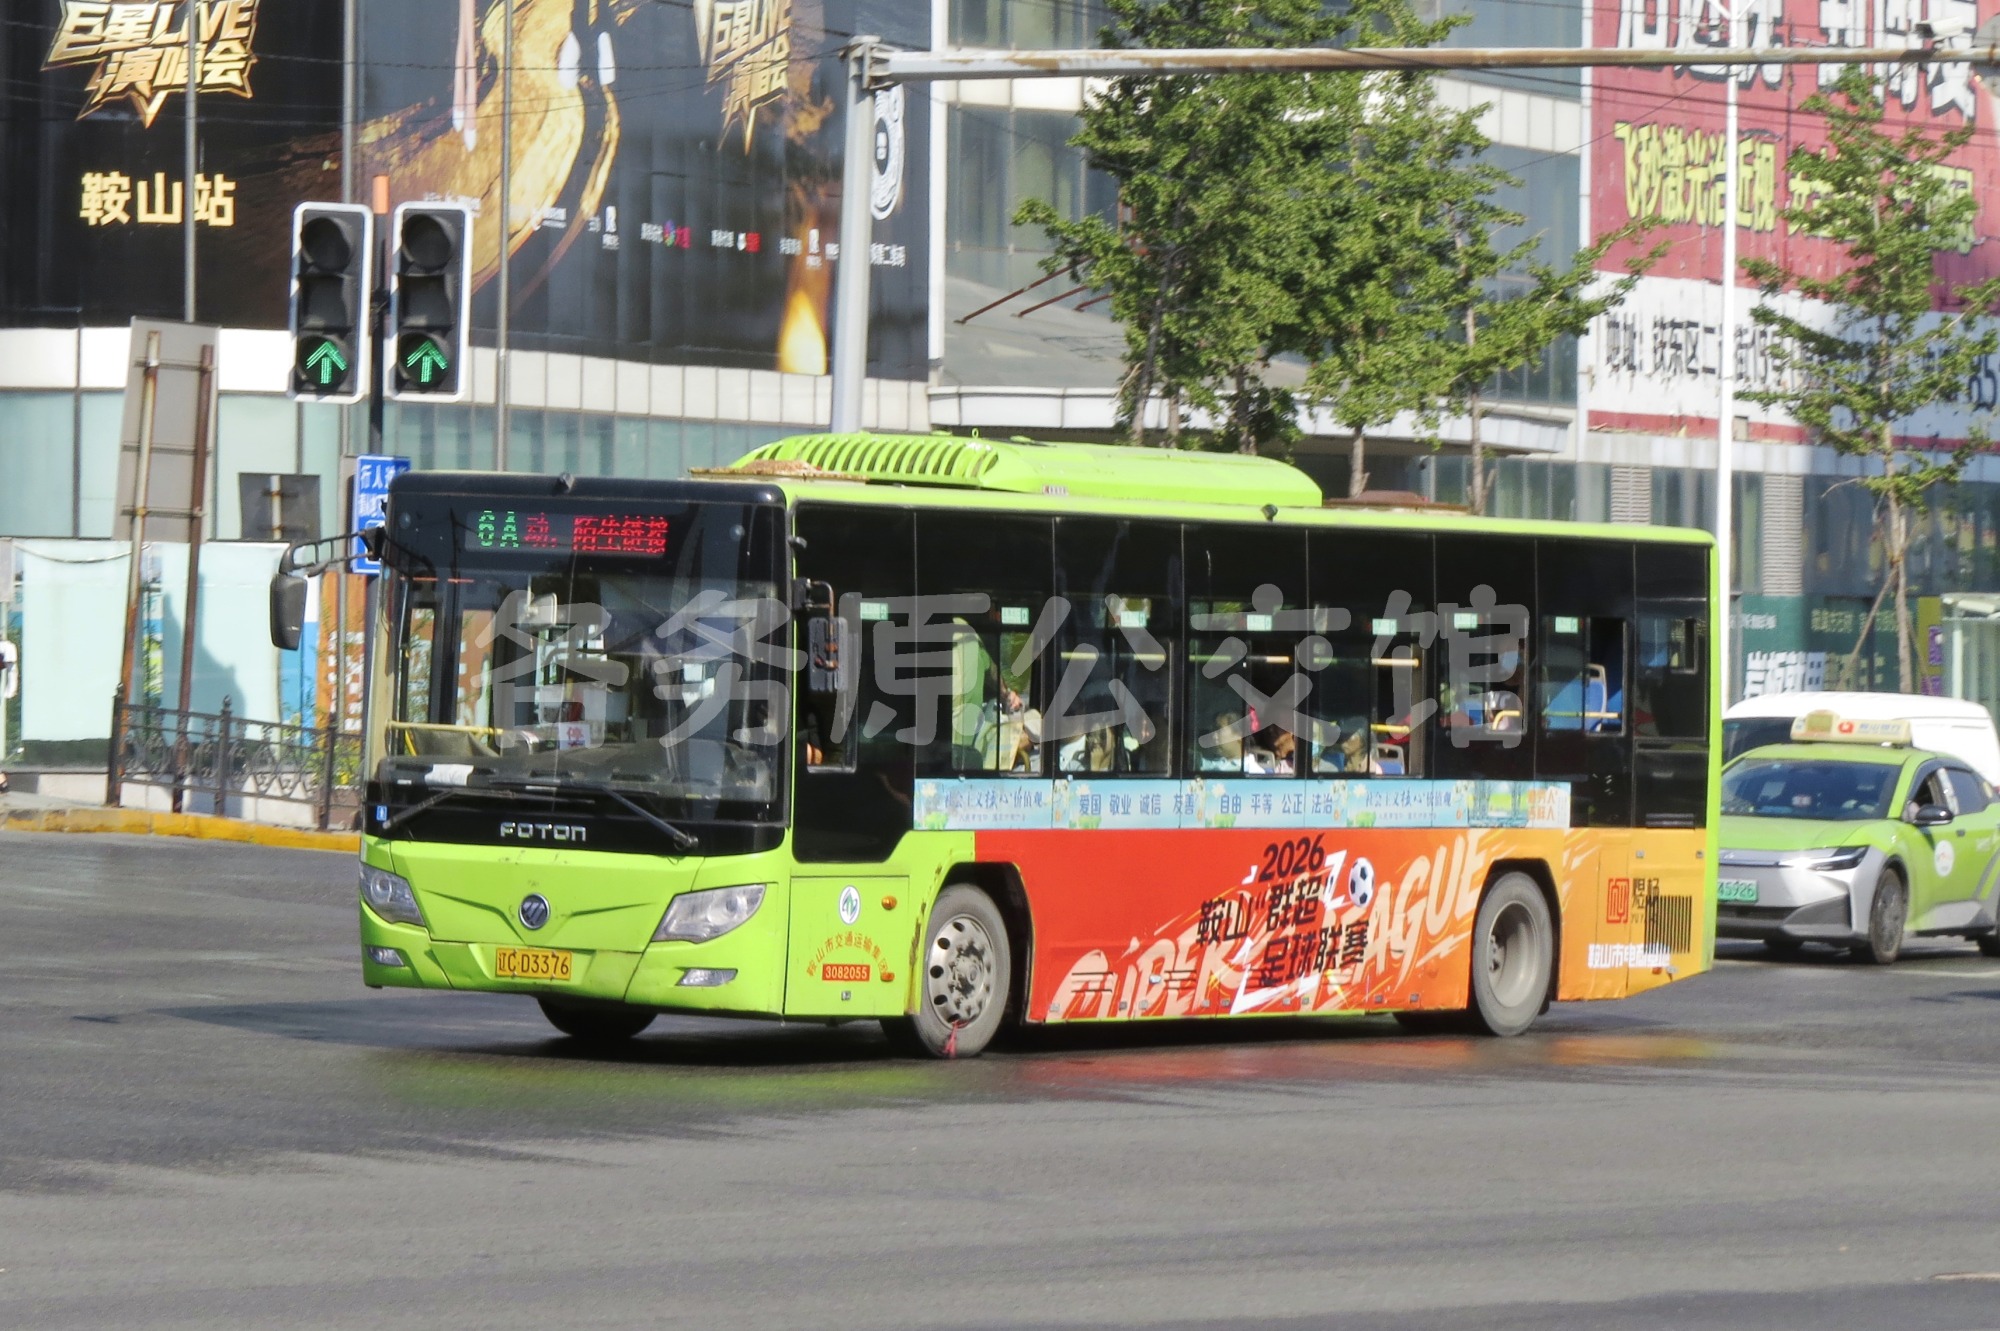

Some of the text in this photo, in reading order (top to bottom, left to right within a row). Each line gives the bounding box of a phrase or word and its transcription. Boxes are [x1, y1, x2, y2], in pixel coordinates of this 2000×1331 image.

[91, 39, 248, 104] 演唱会
[80, 172, 236, 227] 鞍山站
[478, 510, 519, 547] 6A
[1079, 794, 1195, 816] 爱国 敬业 诚信 友善
[1220, 794, 1333, 815] 自由 平等 公正 法治
[500, 822, 586, 842] FOTON
[1258, 833, 1325, 882] 2026
[806, 931, 889, 977] 鞍山市交通运输集团
[825, 965, 868, 979] 3082055
[1261, 920, 1369, 986] 足球联赛
